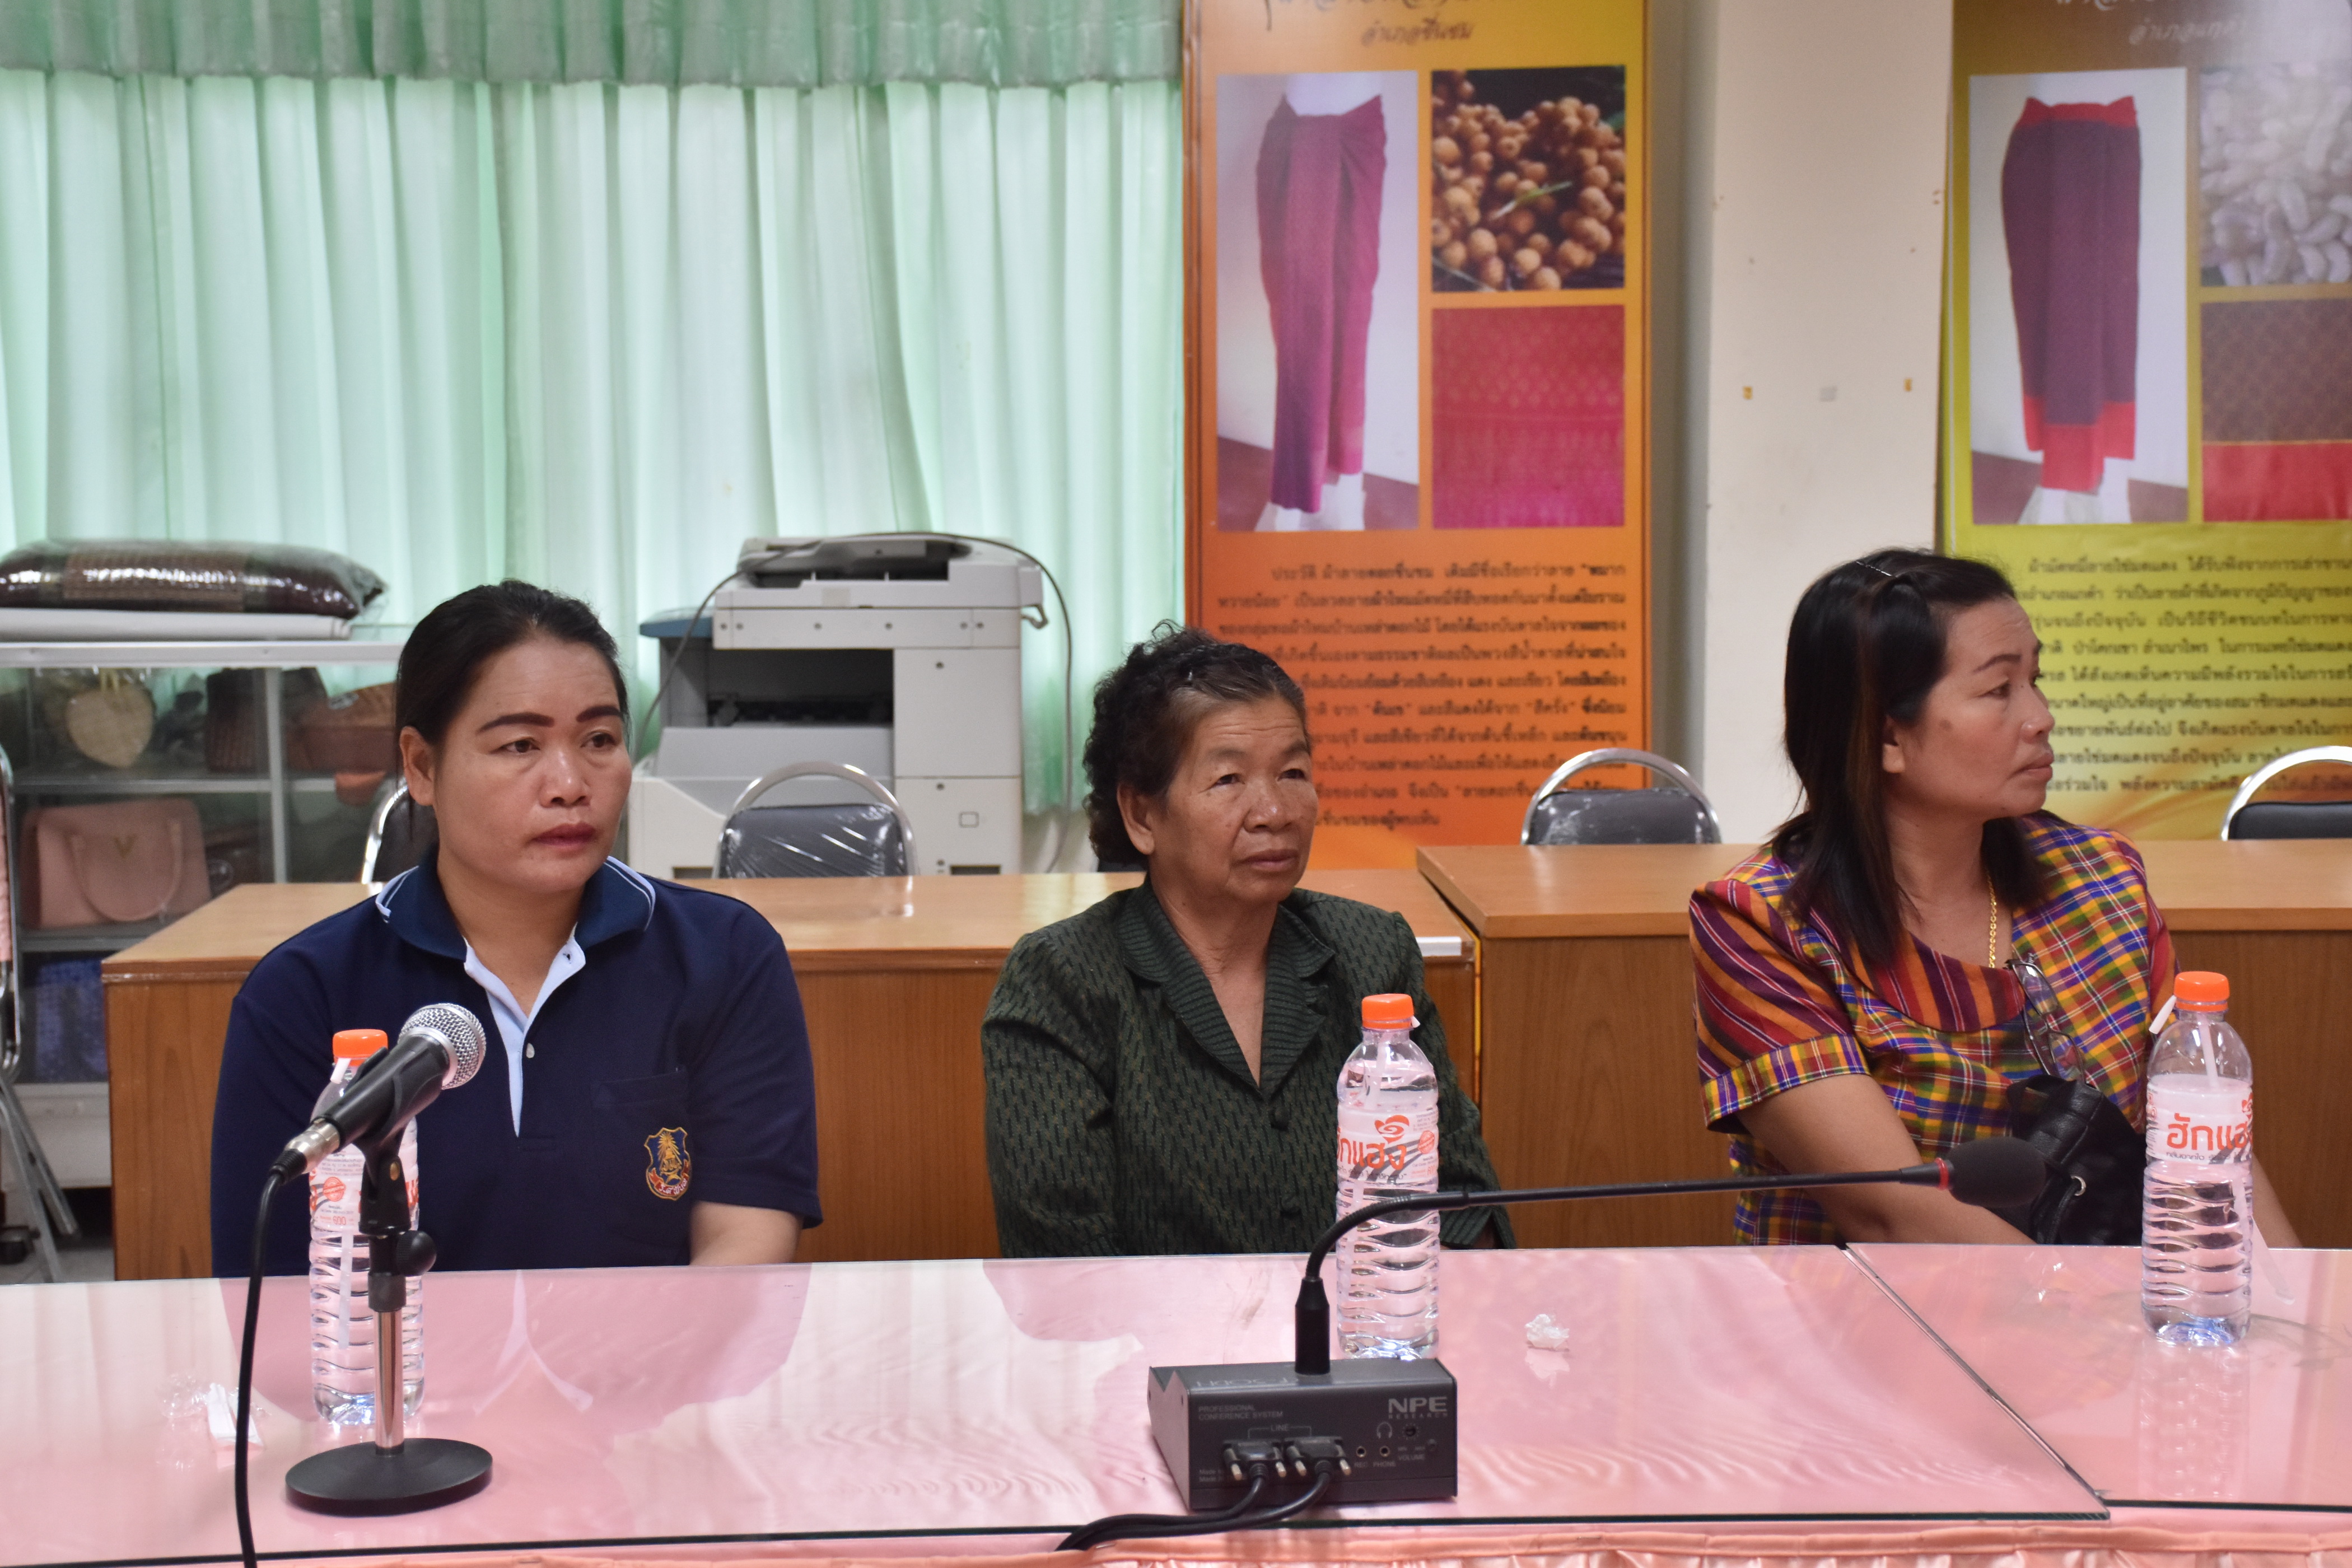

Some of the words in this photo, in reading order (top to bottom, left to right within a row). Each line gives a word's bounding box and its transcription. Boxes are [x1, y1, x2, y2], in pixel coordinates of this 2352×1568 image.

[2167, 1112, 2252, 1151] ฮักแฮ
[333, 1216, 346, 1225] 600
[1388, 1397, 1447, 1413] NPE
[1252, 1411, 1283, 1419] SYSTEM
